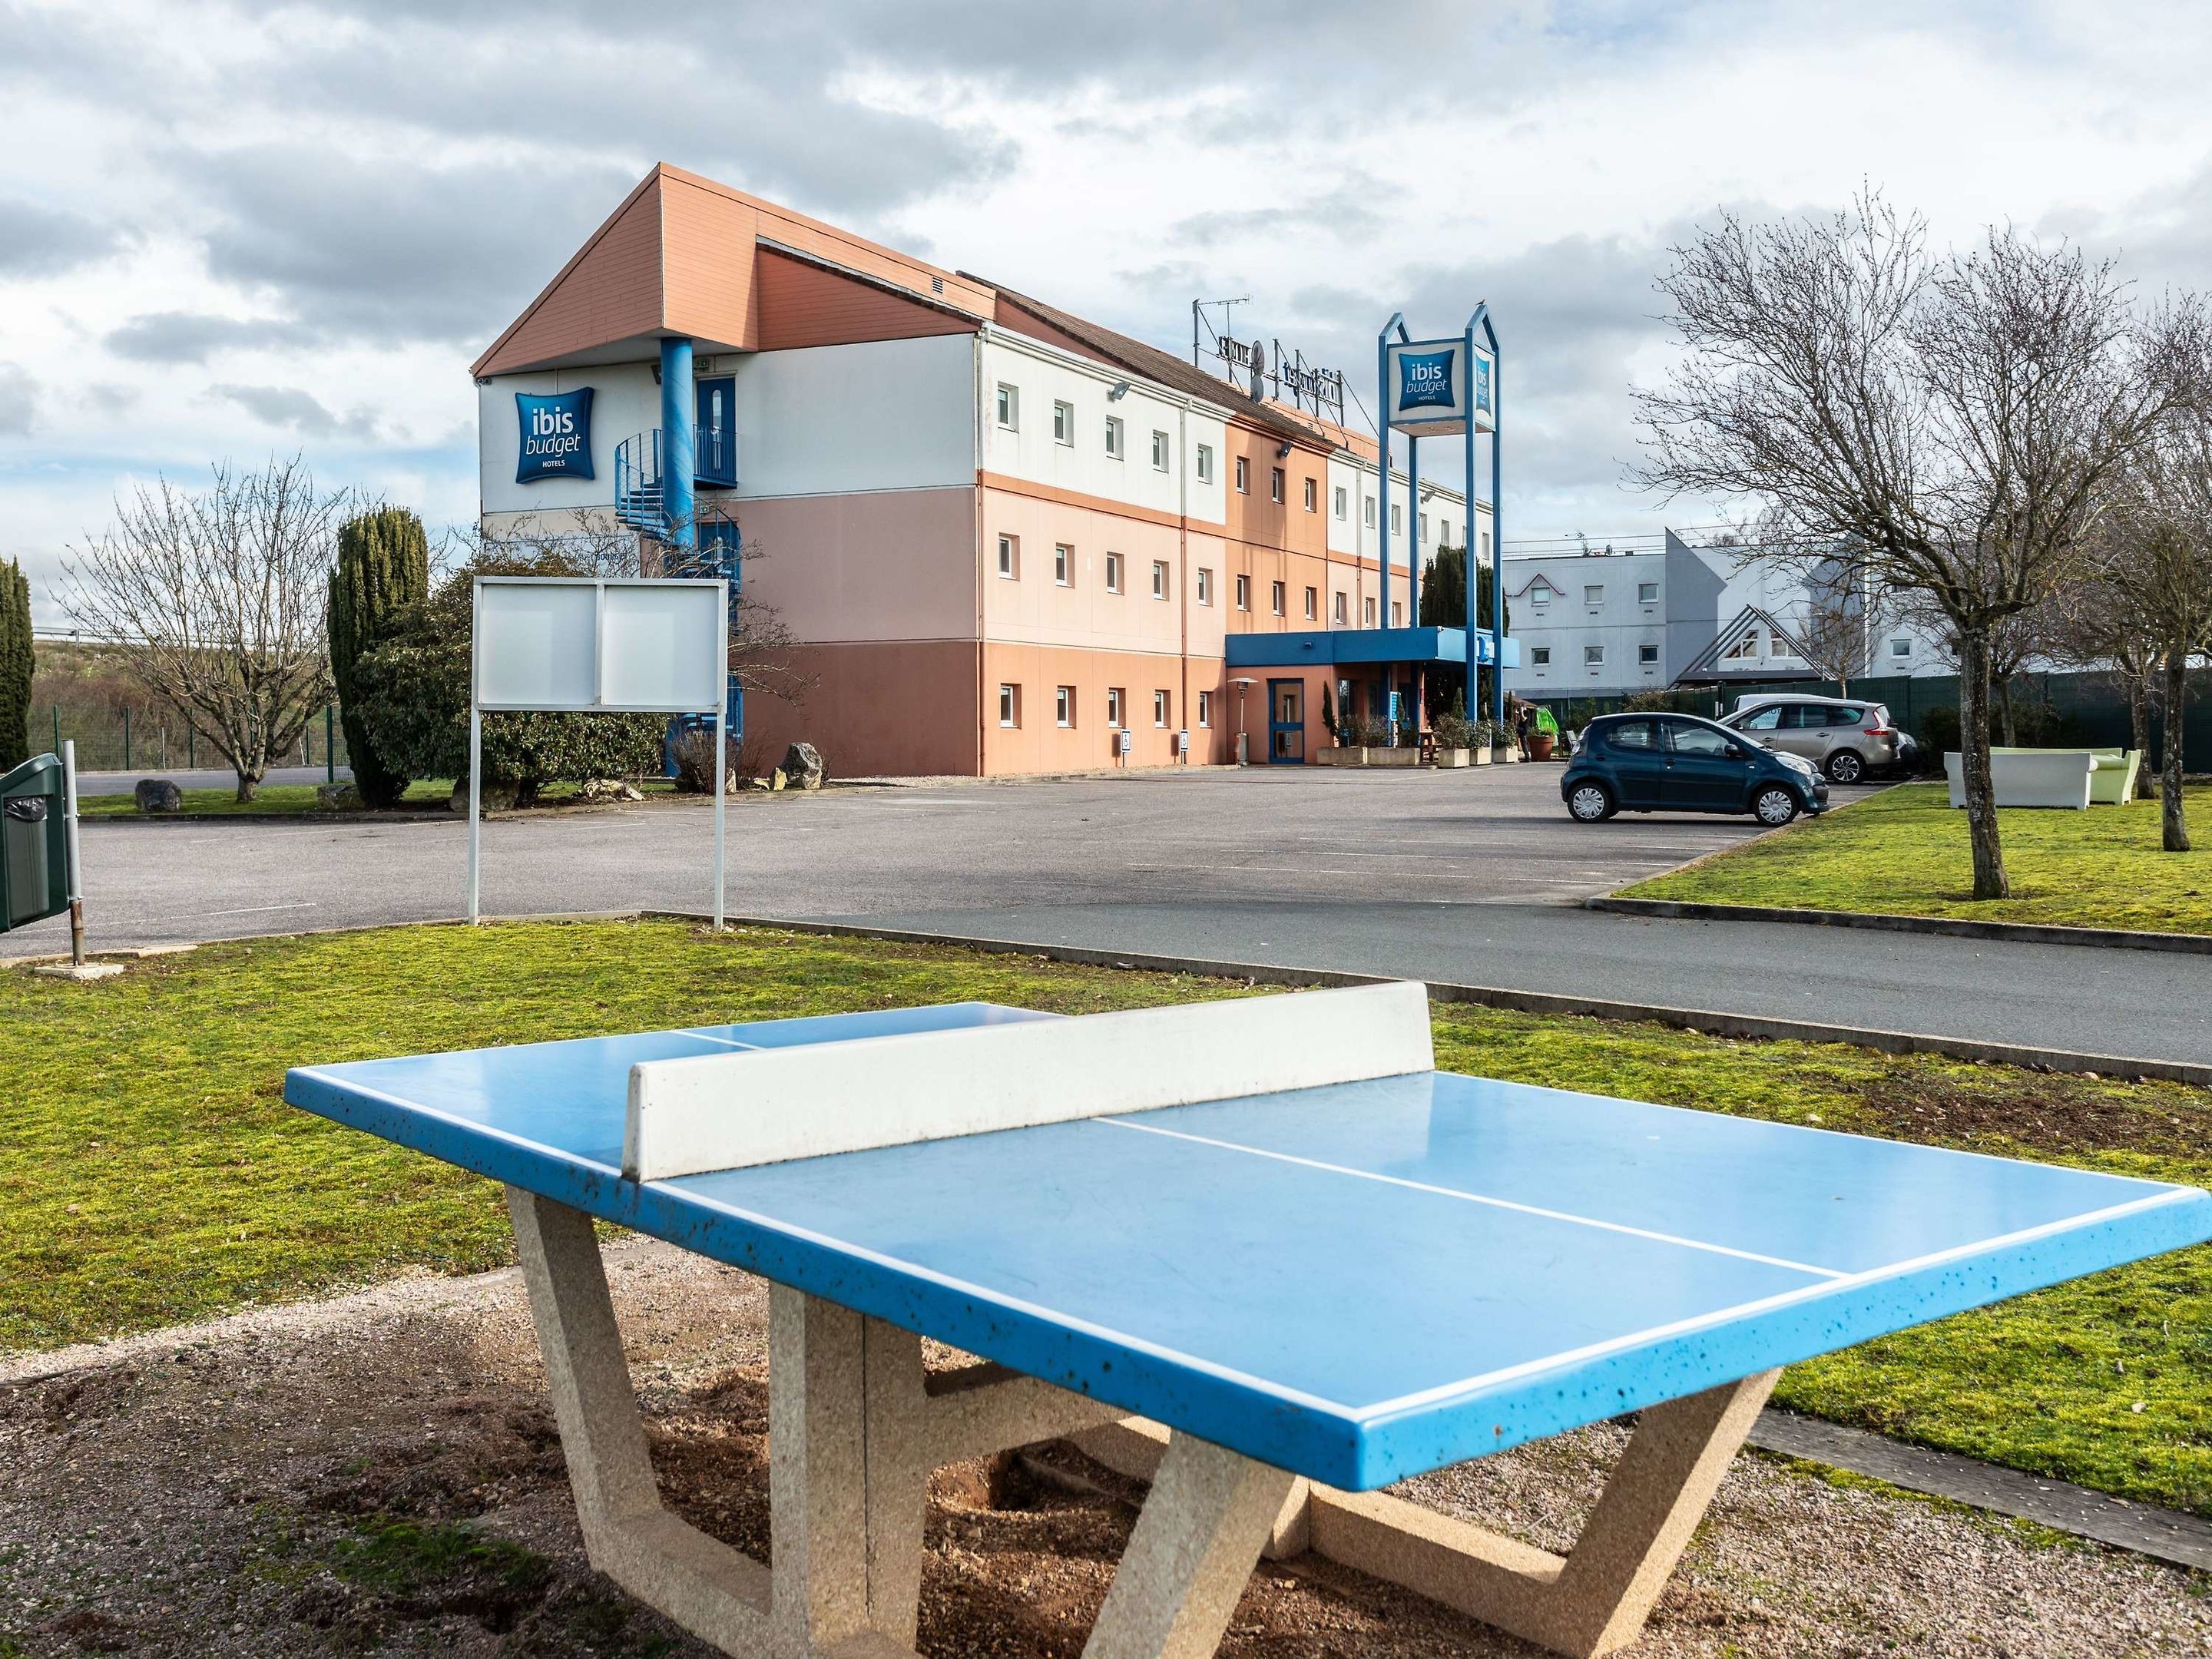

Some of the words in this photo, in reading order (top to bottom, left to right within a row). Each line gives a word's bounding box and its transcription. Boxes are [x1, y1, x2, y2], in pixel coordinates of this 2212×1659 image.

[1412, 363, 1442, 381] ibis
[1406, 379, 1447, 394] budget
[533, 406, 574, 435] ibis
[526, 433, 581, 458] budget
[542, 459, 565, 468] HOTELS
